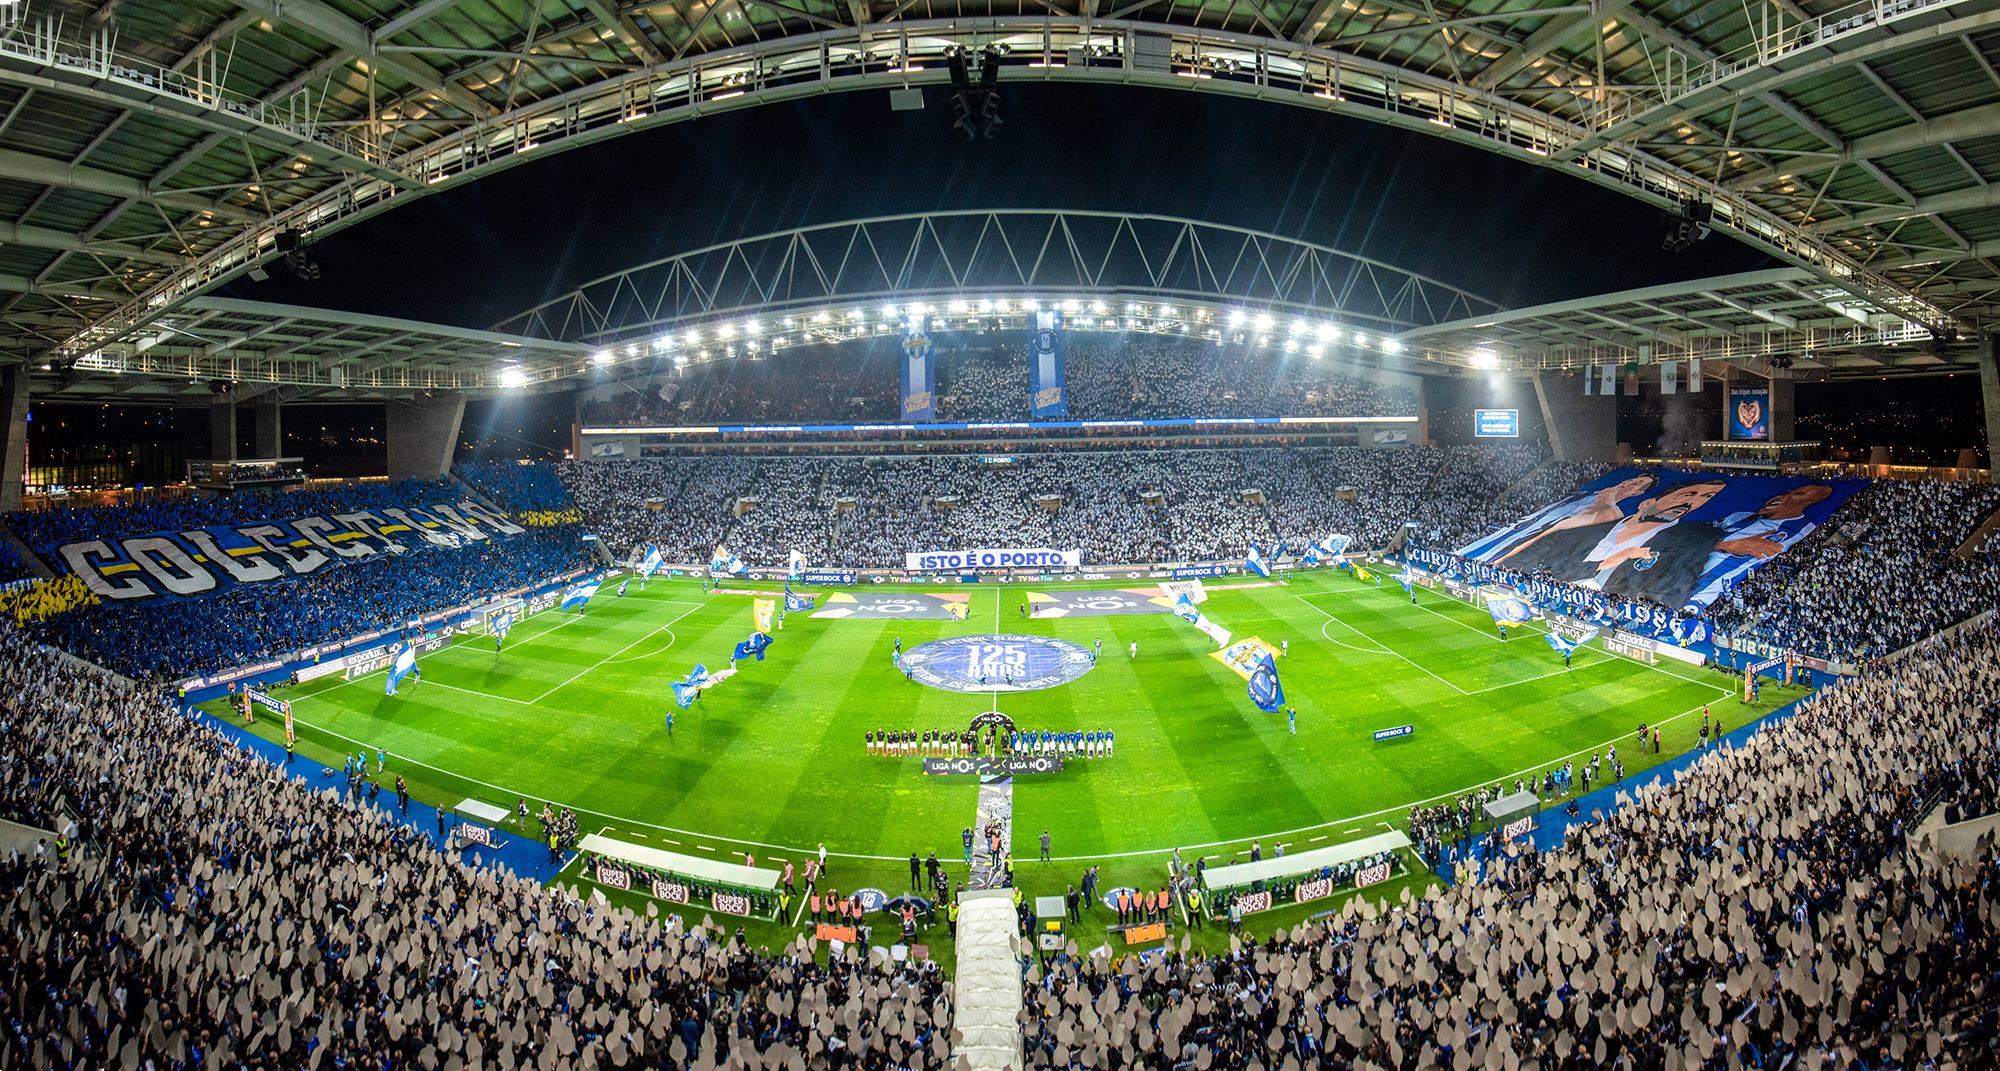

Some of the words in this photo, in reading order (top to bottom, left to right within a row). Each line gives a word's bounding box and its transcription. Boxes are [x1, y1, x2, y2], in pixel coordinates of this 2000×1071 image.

[919, 555, 962, 569] ISTO
[966, 551, 977, 566] É
[981, 553, 996, 566] O
[1000, 552, 1068, 566] PORTO.
[805, 574, 822, 583] SUPER
[822, 573, 841, 582] BOCK
[1176, 568, 1194, 577] SUPER
[1194, 567, 1212, 576] BOCK
[857, 604, 928, 614] NOS
[1067, 600, 1138, 610] NOS
[967, 644, 1027, 665] 125
[968, 664, 1026, 678] ANOS
[1756, 661, 1770, 672] SUPER
[1769, 657, 1783, 668] BOCK
[218, 673, 237, 682] VOLTA
[245, 665, 264, 676] NOSSO
[1020, 676, 1061, 690] PORTO
[1375, 731, 1390, 739] SUPER
[1389, 728, 1404, 736] BOCK
[951, 759, 975, 773] NOS
[1009, 762, 1028, 770] LIGA
[1029, 758, 1053, 772] NOS
[465, 824, 486, 838] SUPER
[467, 831, 486, 844] BOCK
[600, 867, 625, 881] SUPER
[1360, 864, 1386, 880] SUPER
[1362, 872, 1386, 886] BOCK
[602, 875, 625, 888] BOCK
[657, 882, 683, 895] SUPER
[1300, 879, 1327, 894] SUPER
[659, 889, 683, 901] BOCK
[717, 894, 744, 906] SUPER
[1237, 892, 1266, 908] SUPER
[1302, 888, 1327, 901] BOCK
[719, 902, 744, 914] BOCK
[1240, 901, 1266, 914] BOCK
